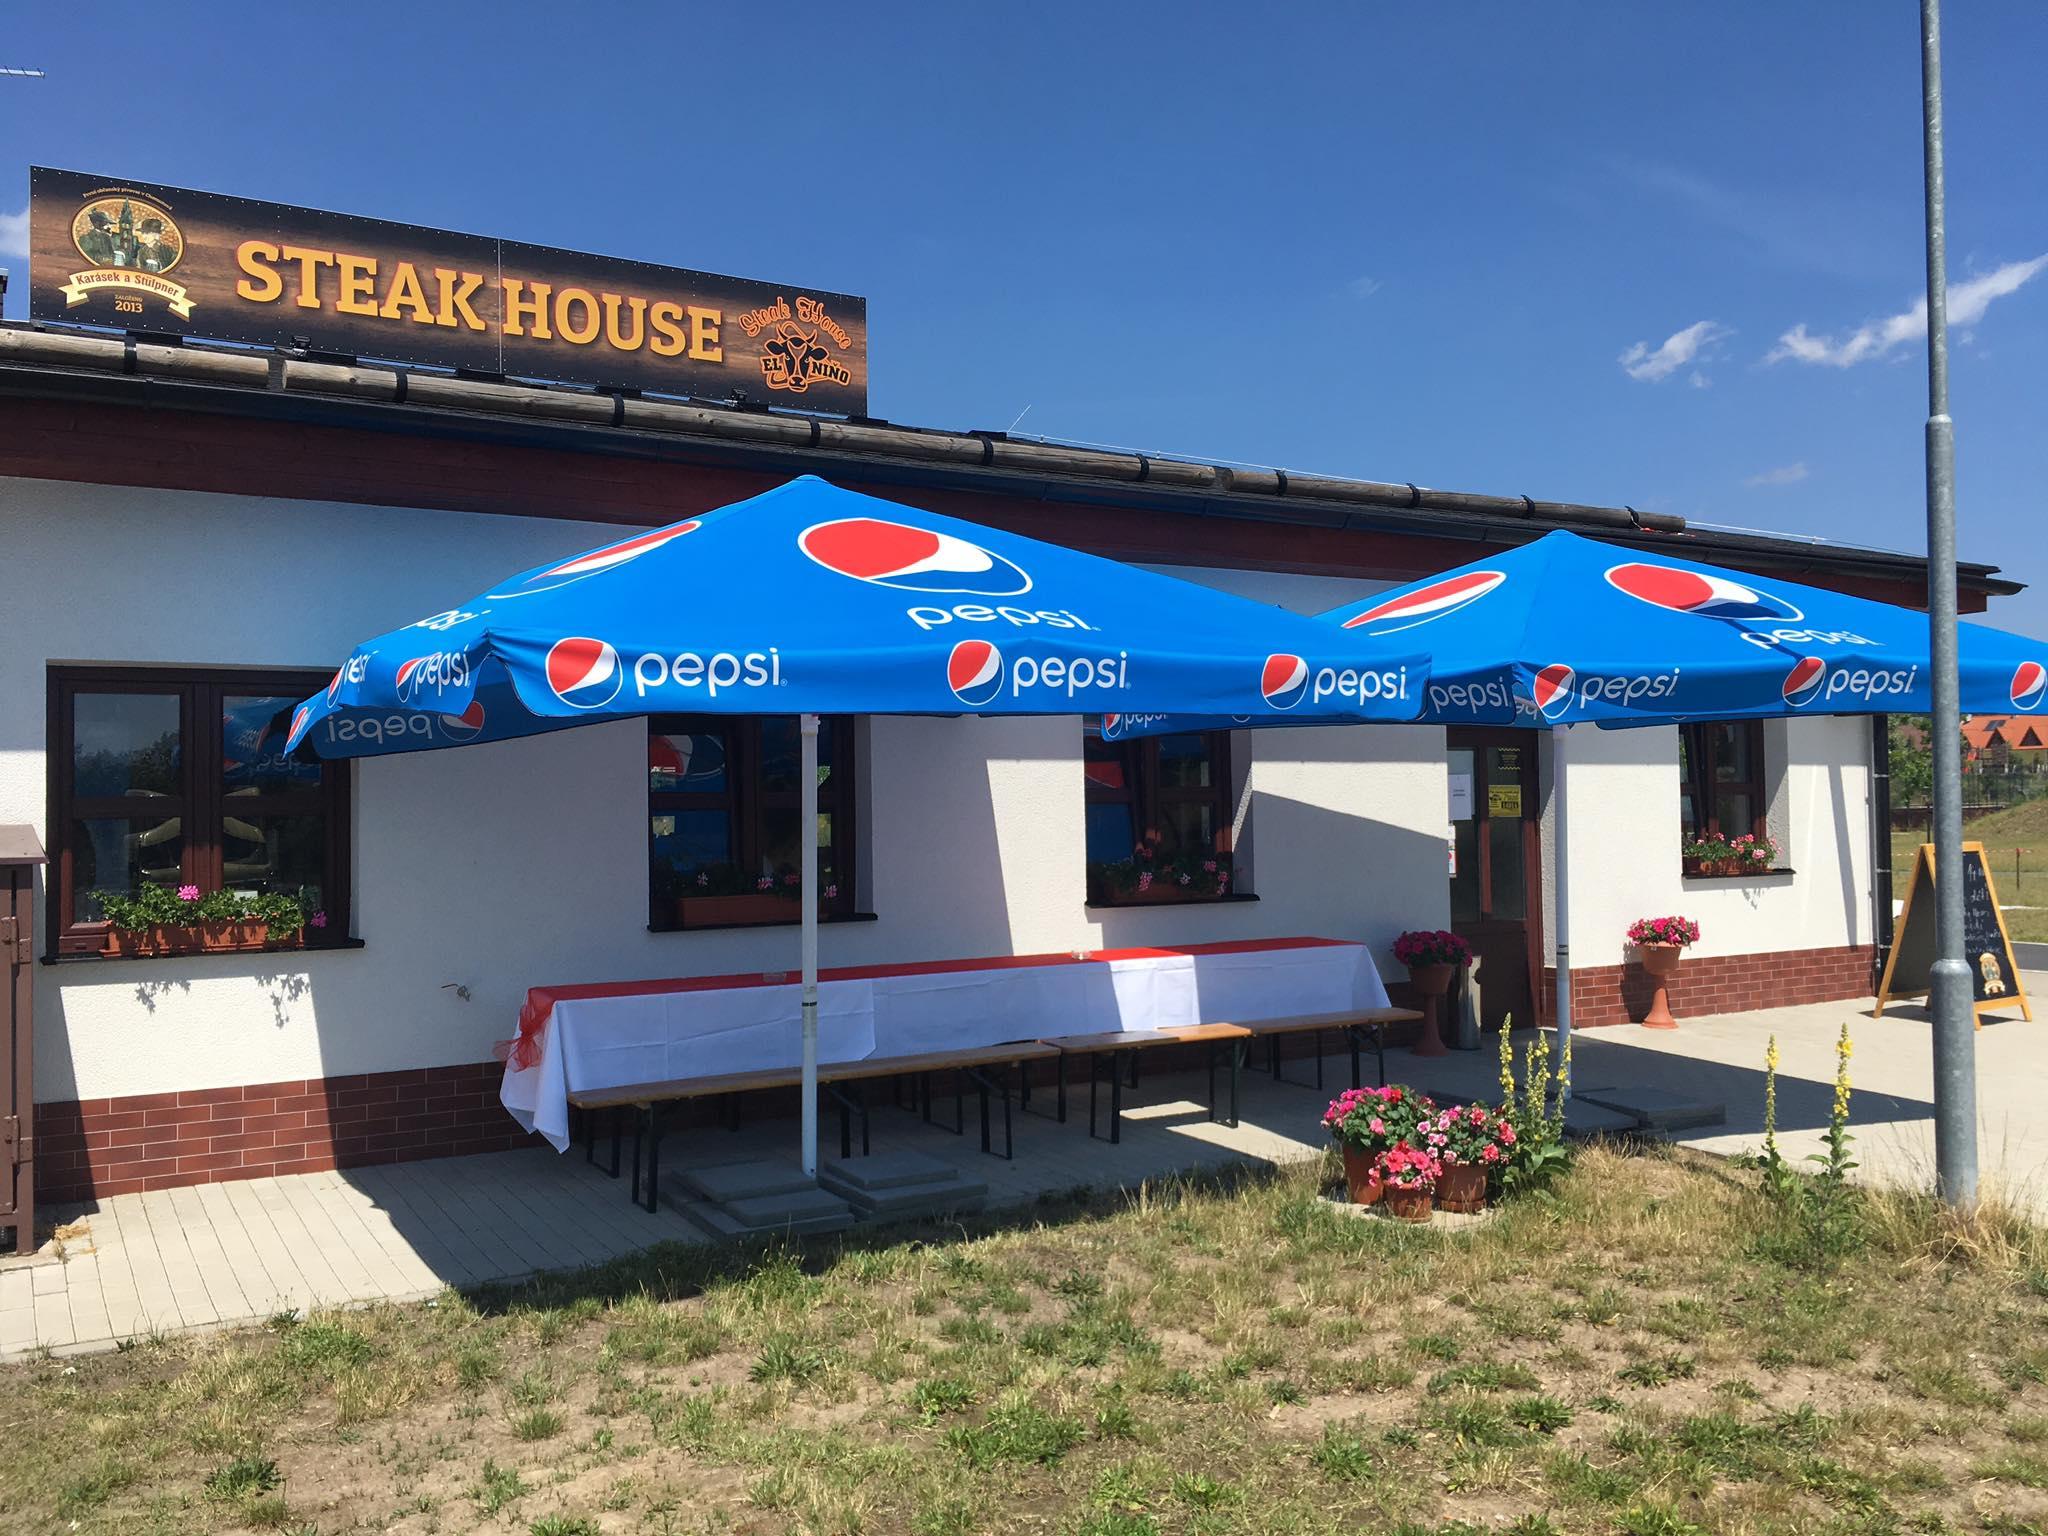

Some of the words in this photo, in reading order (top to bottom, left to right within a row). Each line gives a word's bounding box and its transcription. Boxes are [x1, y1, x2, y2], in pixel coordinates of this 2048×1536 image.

[75, 271, 120, 285] Karásek
[135, 273, 179, 297] Stülpner
[235, 240, 486, 332] STEAK
[501, 278, 724, 363] HOUSE
[115, 300, 143, 313] 2013
[740, 297, 791, 337] Steak
[796, 297, 851, 349] House
[762, 358, 782, 372] EL
[907, 604, 1091, 630] pepsi
[1740, 629, 1880, 649] pepsi
[415, 644, 469, 697] pepsi
[634, 647, 781, 697] pepsi
[1013, 651, 1127, 697] pepsi
[1314, 665, 1407, 705] pepsi
[1579, 667, 1680, 709] pepsi
[1825, 664, 1918, 701] pepsi
[1429, 676, 1508, 714] pepsi
